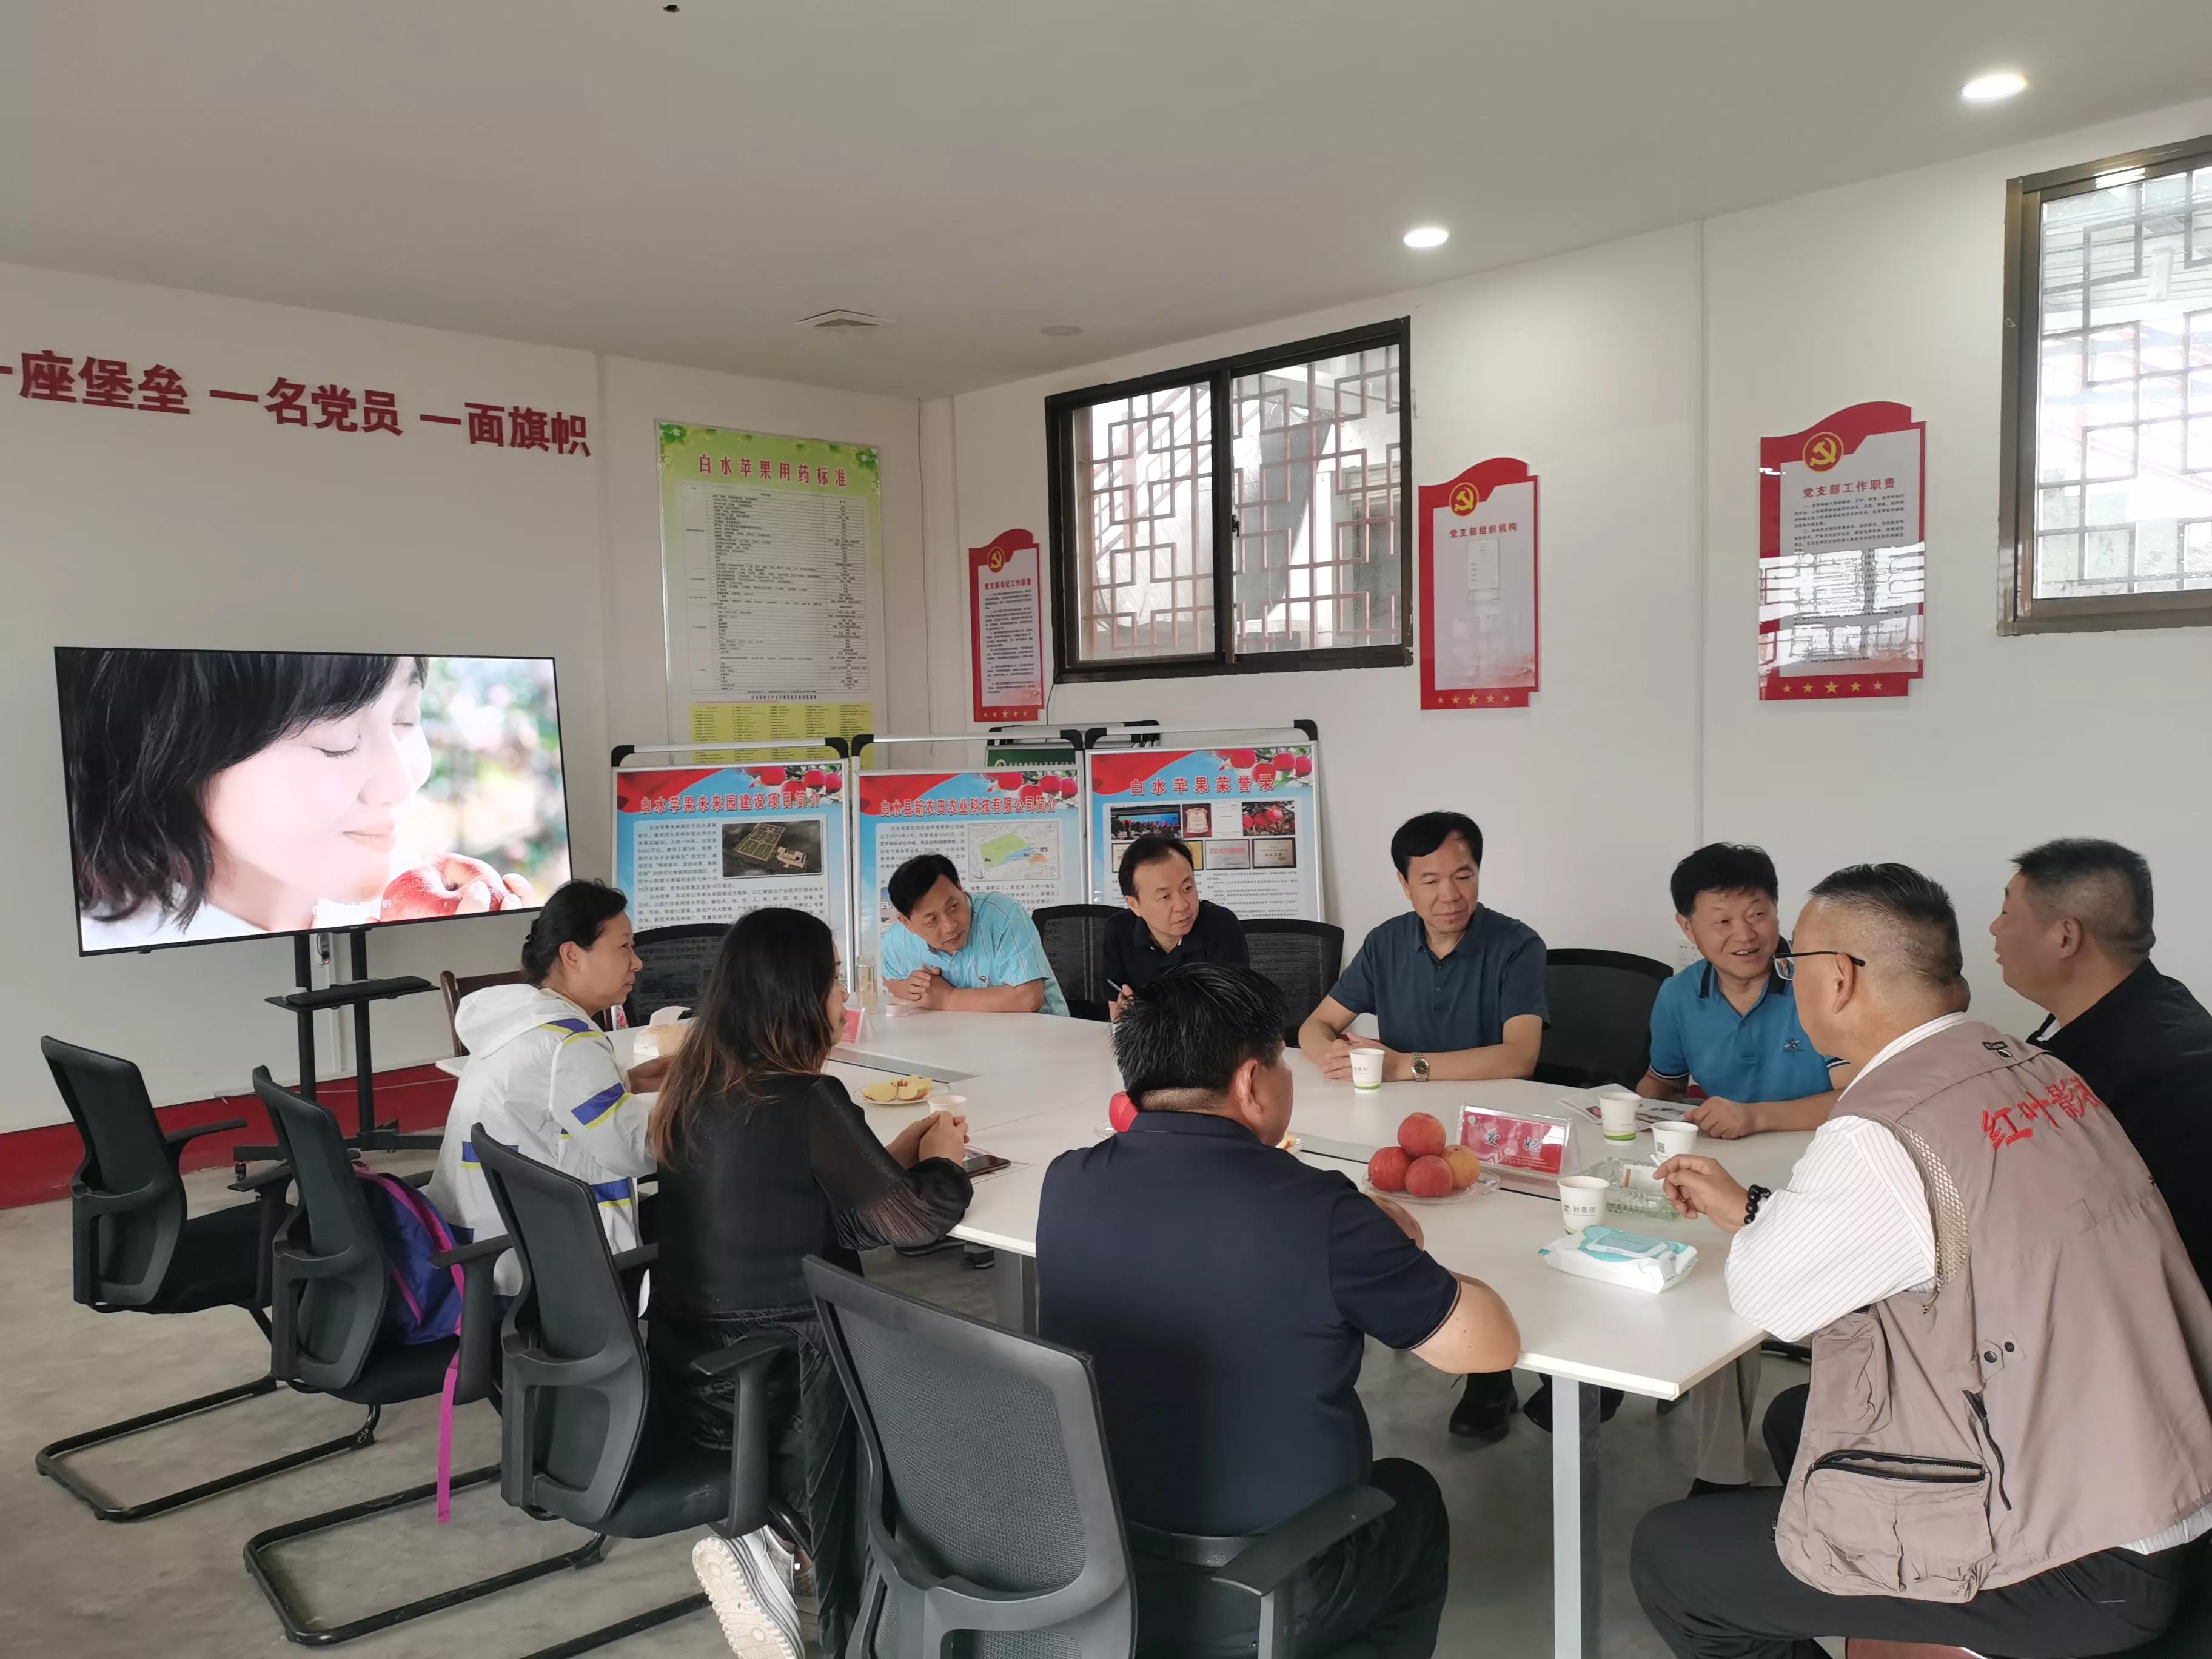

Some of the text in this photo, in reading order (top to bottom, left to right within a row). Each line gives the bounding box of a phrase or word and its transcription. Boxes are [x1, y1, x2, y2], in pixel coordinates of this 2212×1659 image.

[0, 350, 591, 457] 座堡垒 一名党员 一面旗帜
[699, 454, 847, 487] 白水苹果用药标准
[1802, 477, 1896, 498] 党支部工作职责
[1449, 522, 1517, 539] 党支部组织机构
[1130, 773, 1275, 796] 白水苹果荣誉录
[640, 791, 822, 814] 白水苹果未来园建设项目简介
[880, 796, 1057, 817] 白水县新农田农业科技有限公司简介
